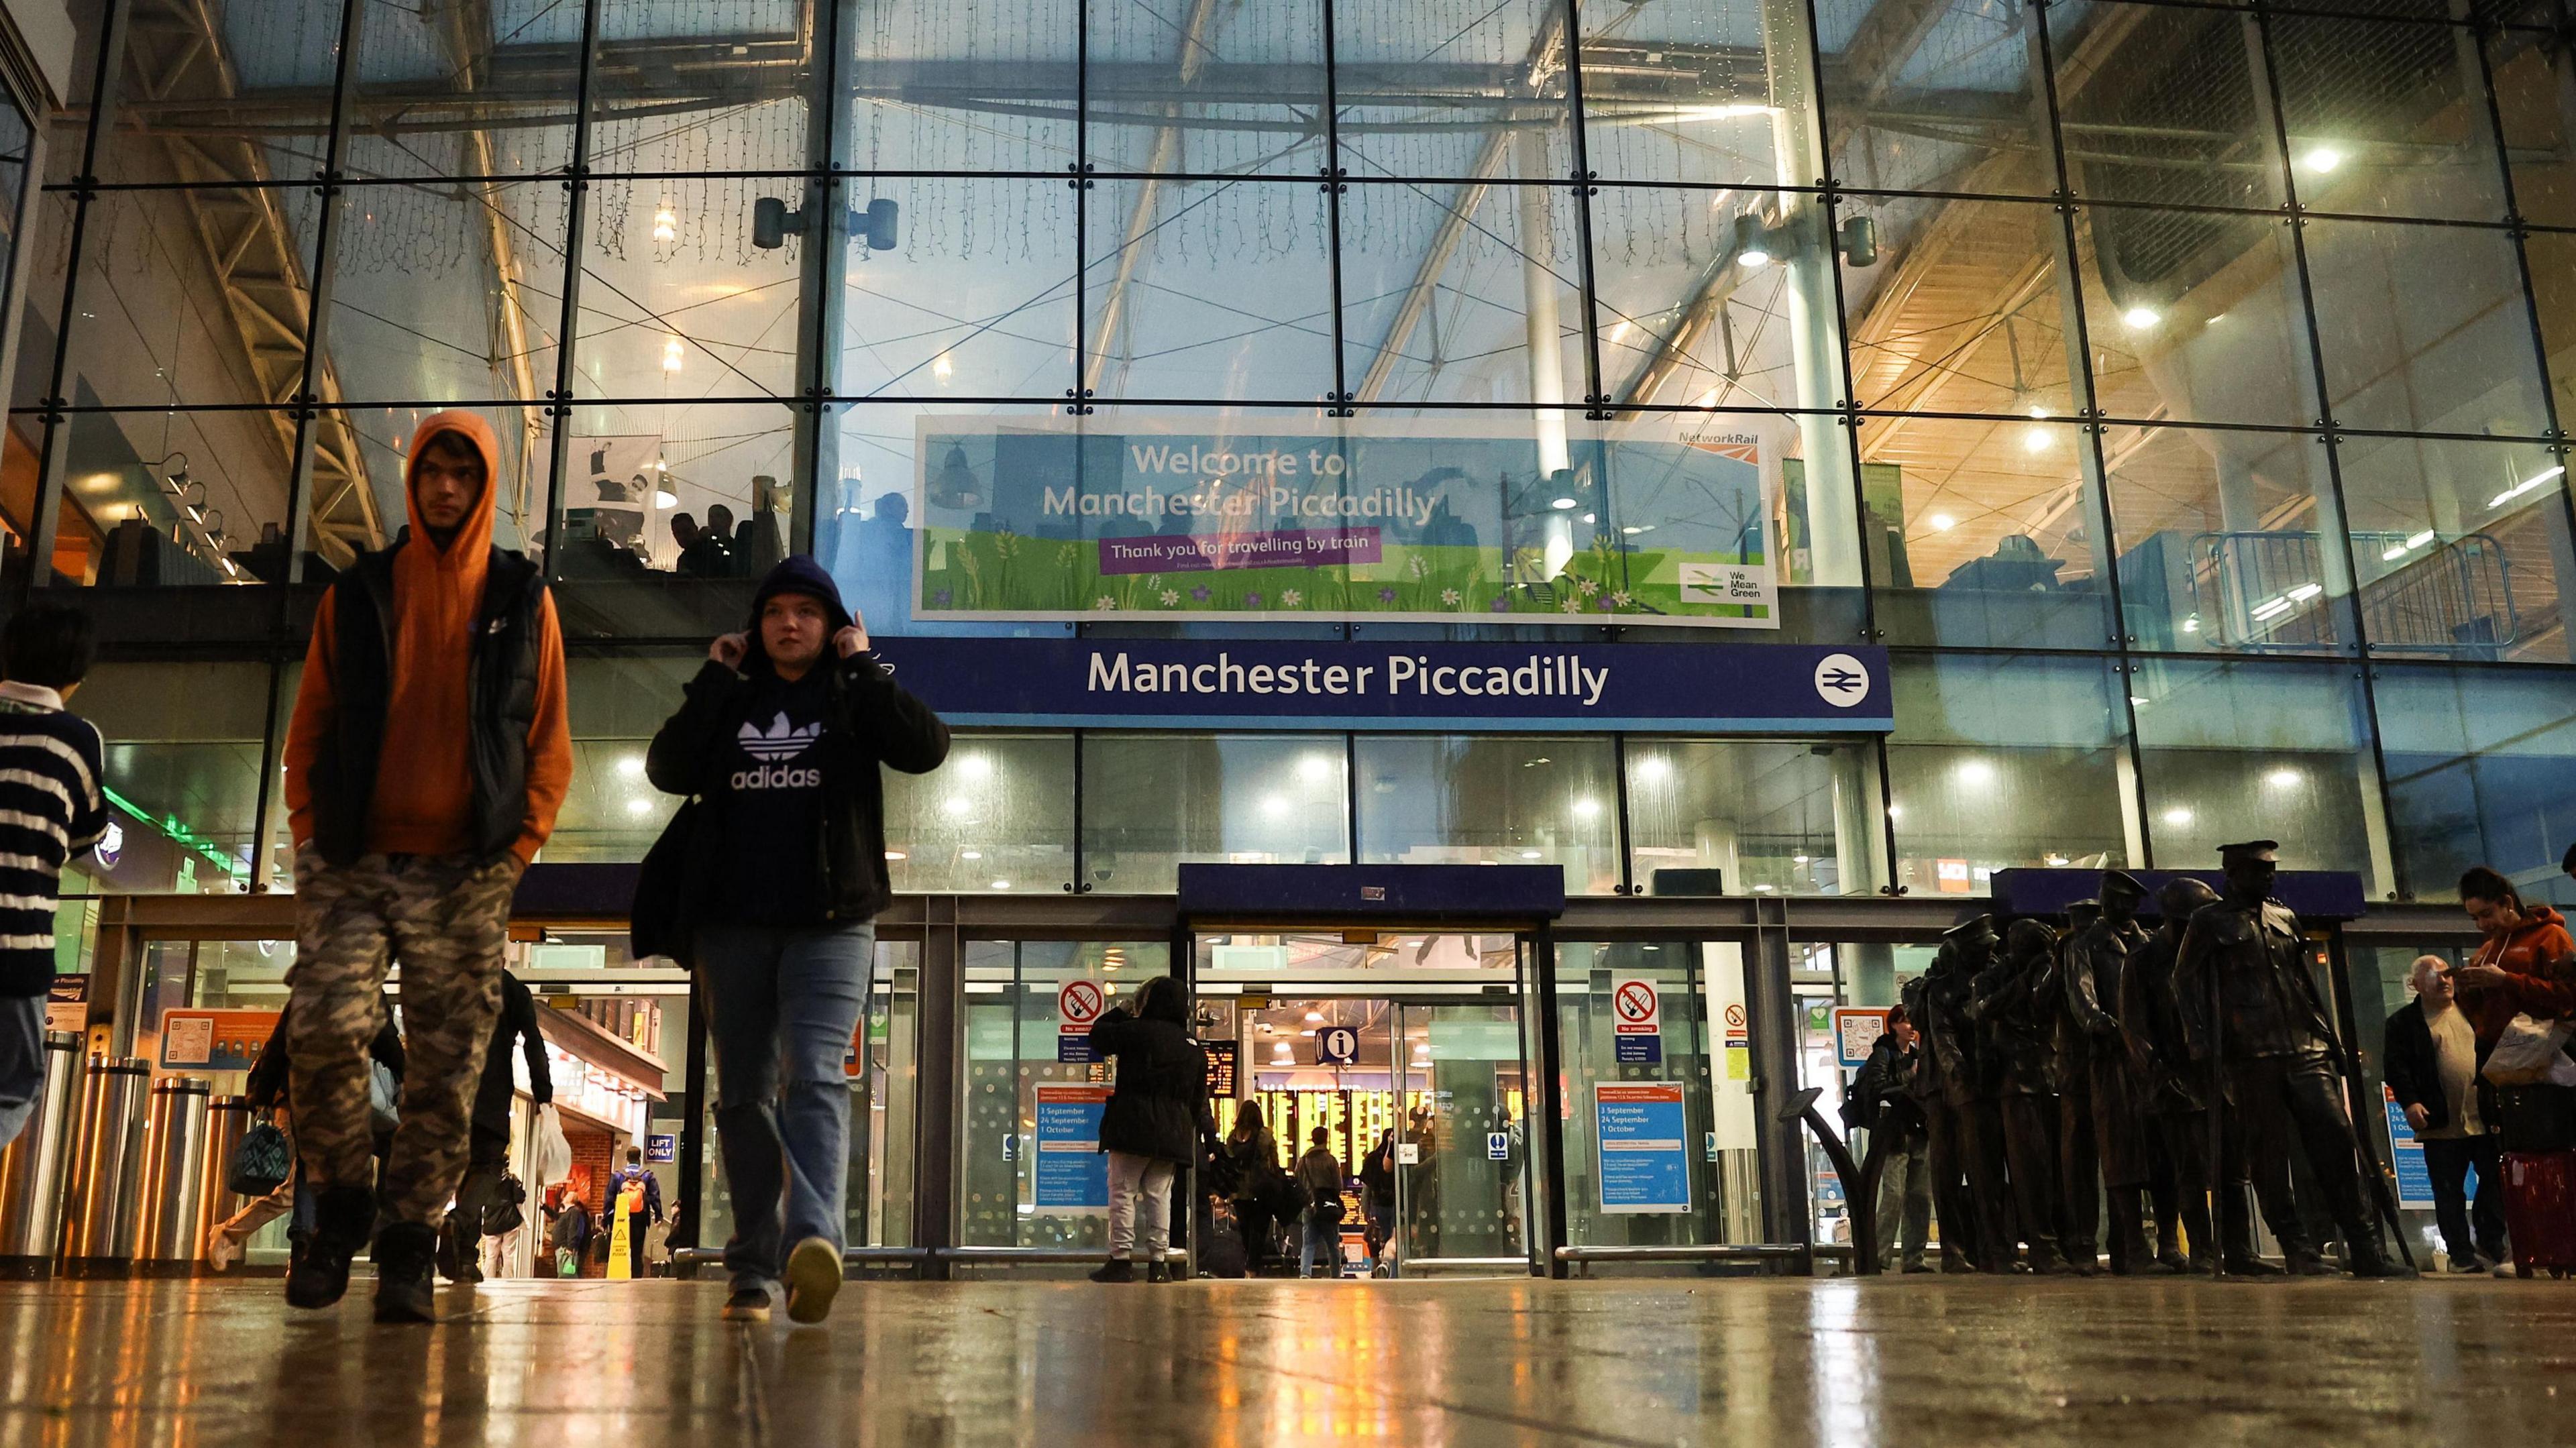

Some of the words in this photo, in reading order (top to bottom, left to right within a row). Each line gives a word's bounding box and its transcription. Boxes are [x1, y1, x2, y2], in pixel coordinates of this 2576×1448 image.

[1679, 432, 1758, 444] NetworkRail
[1131, 445, 1297, 475] Welcome
[1307, 449, 1346, 476] to
[1043, 486, 1258, 516] Manchester
[1269, 487, 1436, 525] Piccadilly
[1111, 543, 1162, 558] Thank
[1167, 543, 1196, 559] you
[1201, 541, 1224, 557] for
[1228, 537, 1302, 554] travelling
[1307, 536, 1326, 553] by
[1331, 535, 1368, 549] train
[1729, 571, 1745, 580] We
[1731, 580, 1758, 589] Mean
[1731, 588, 1760, 598] Green
[1087, 651, 1374, 695] Manchester
[1388, 654, 1609, 706] Piccadilly
[731, 765, 821, 791] adidas
[1046, 1107, 1085, 1115] September
[1607, 1107, 1644, 1115] September
[1051, 1117, 1089, 1125] September
[1612, 1116, 1649, 1125] September
[651, 1139, 671, 1148] LIFT
[648, 1148, 672, 1157] ONLY
